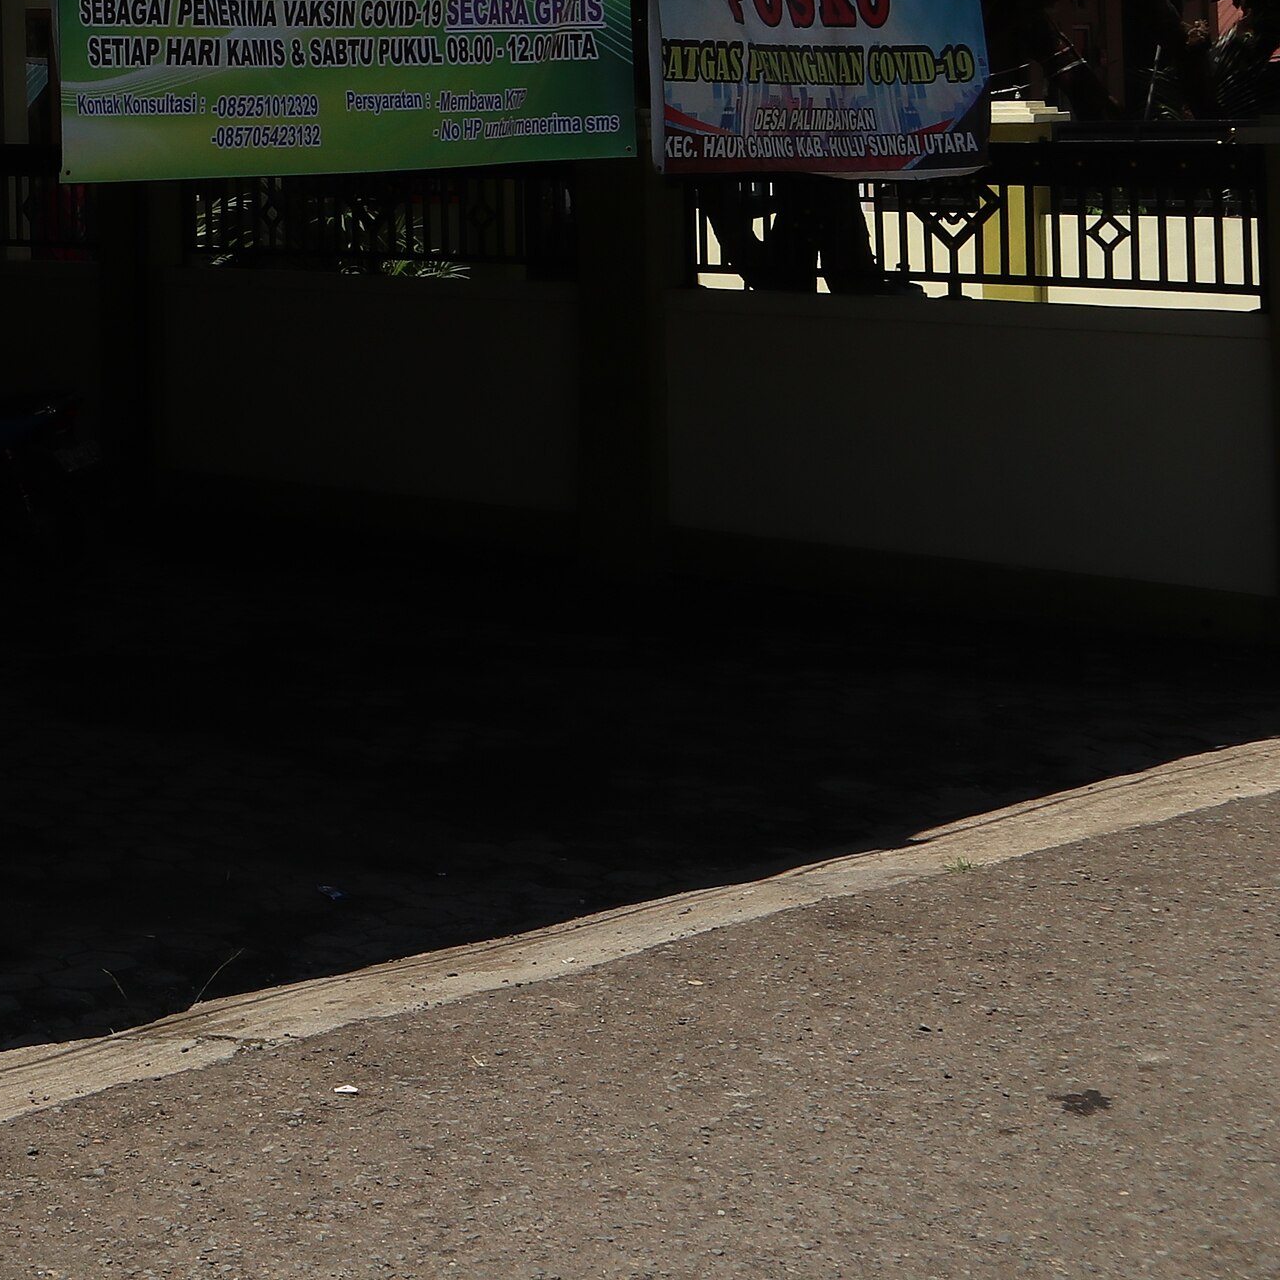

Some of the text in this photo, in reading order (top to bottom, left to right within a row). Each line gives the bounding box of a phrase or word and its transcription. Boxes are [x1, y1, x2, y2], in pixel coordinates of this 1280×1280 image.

[283, 0, 356, 28] VAKSIN
[360, 0, 442, 28] COVID-19
[88, 37, 160, 67] SETIAP
[165, 38, 221, 67] HARI
[226, 38, 285, 67] KAMIS
[290, 38, 305, 66] &
[310, 38, 373, 66] SABTU
[378, 37, 443, 66] PUKUL
[446, 36, 494, 64] 08.00
[747, 42, 865, 86] PENANGANAN
[867, 43, 975, 85] COVID-19
[76, 94, 122, 115] Kontak
[123, 93, 197, 115] Konsultasi
[346, 90, 423, 116] Persyaratan
[504, 88, 528, 111] KTP
[441, 120, 460, 141] No
[463, 121, 482, 141] HP
[485, 118, 515, 139] untuk
[514, 114, 582, 138] menerima
[585, 114, 620, 132] sms
[753, 107, 877, 132] DESA PALIMBANGAN
[702, 134, 747, 159] HAUR
[747, 135, 794, 159] GADING
[795, 134, 829, 158] KAB.
[828, 134, 865, 158] HULU
[866, 133, 921, 157] SUNGAI
[923, 130, 979, 155] UTARA
